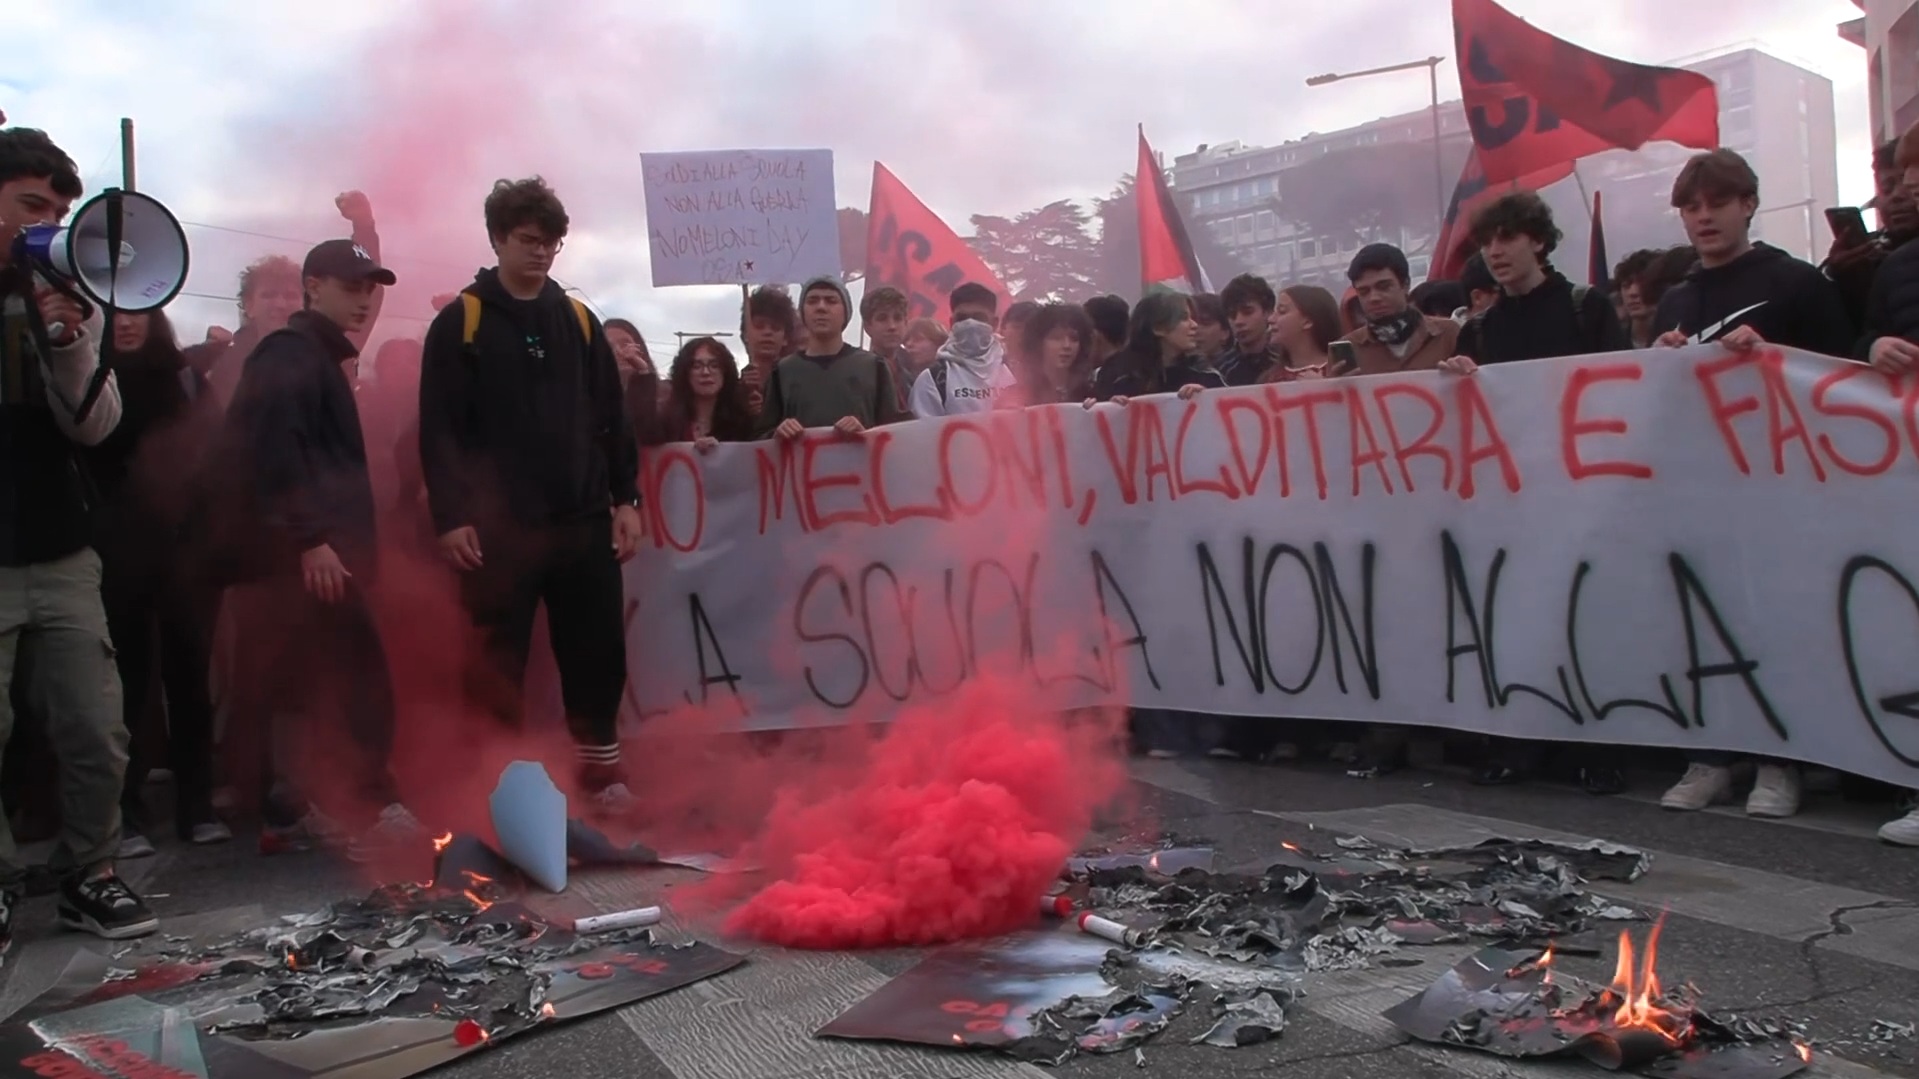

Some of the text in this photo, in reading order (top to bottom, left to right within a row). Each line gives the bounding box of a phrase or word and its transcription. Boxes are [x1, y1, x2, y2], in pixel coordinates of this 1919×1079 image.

[664, 192, 700, 214] NON
[707, 187, 744, 211] ALLA
[703, 160, 737, 181] ALLA
[1560, 364, 1652, 481] E
[1197, 536, 1381, 701] NON
[1441, 529, 1789, 741] ALLA
